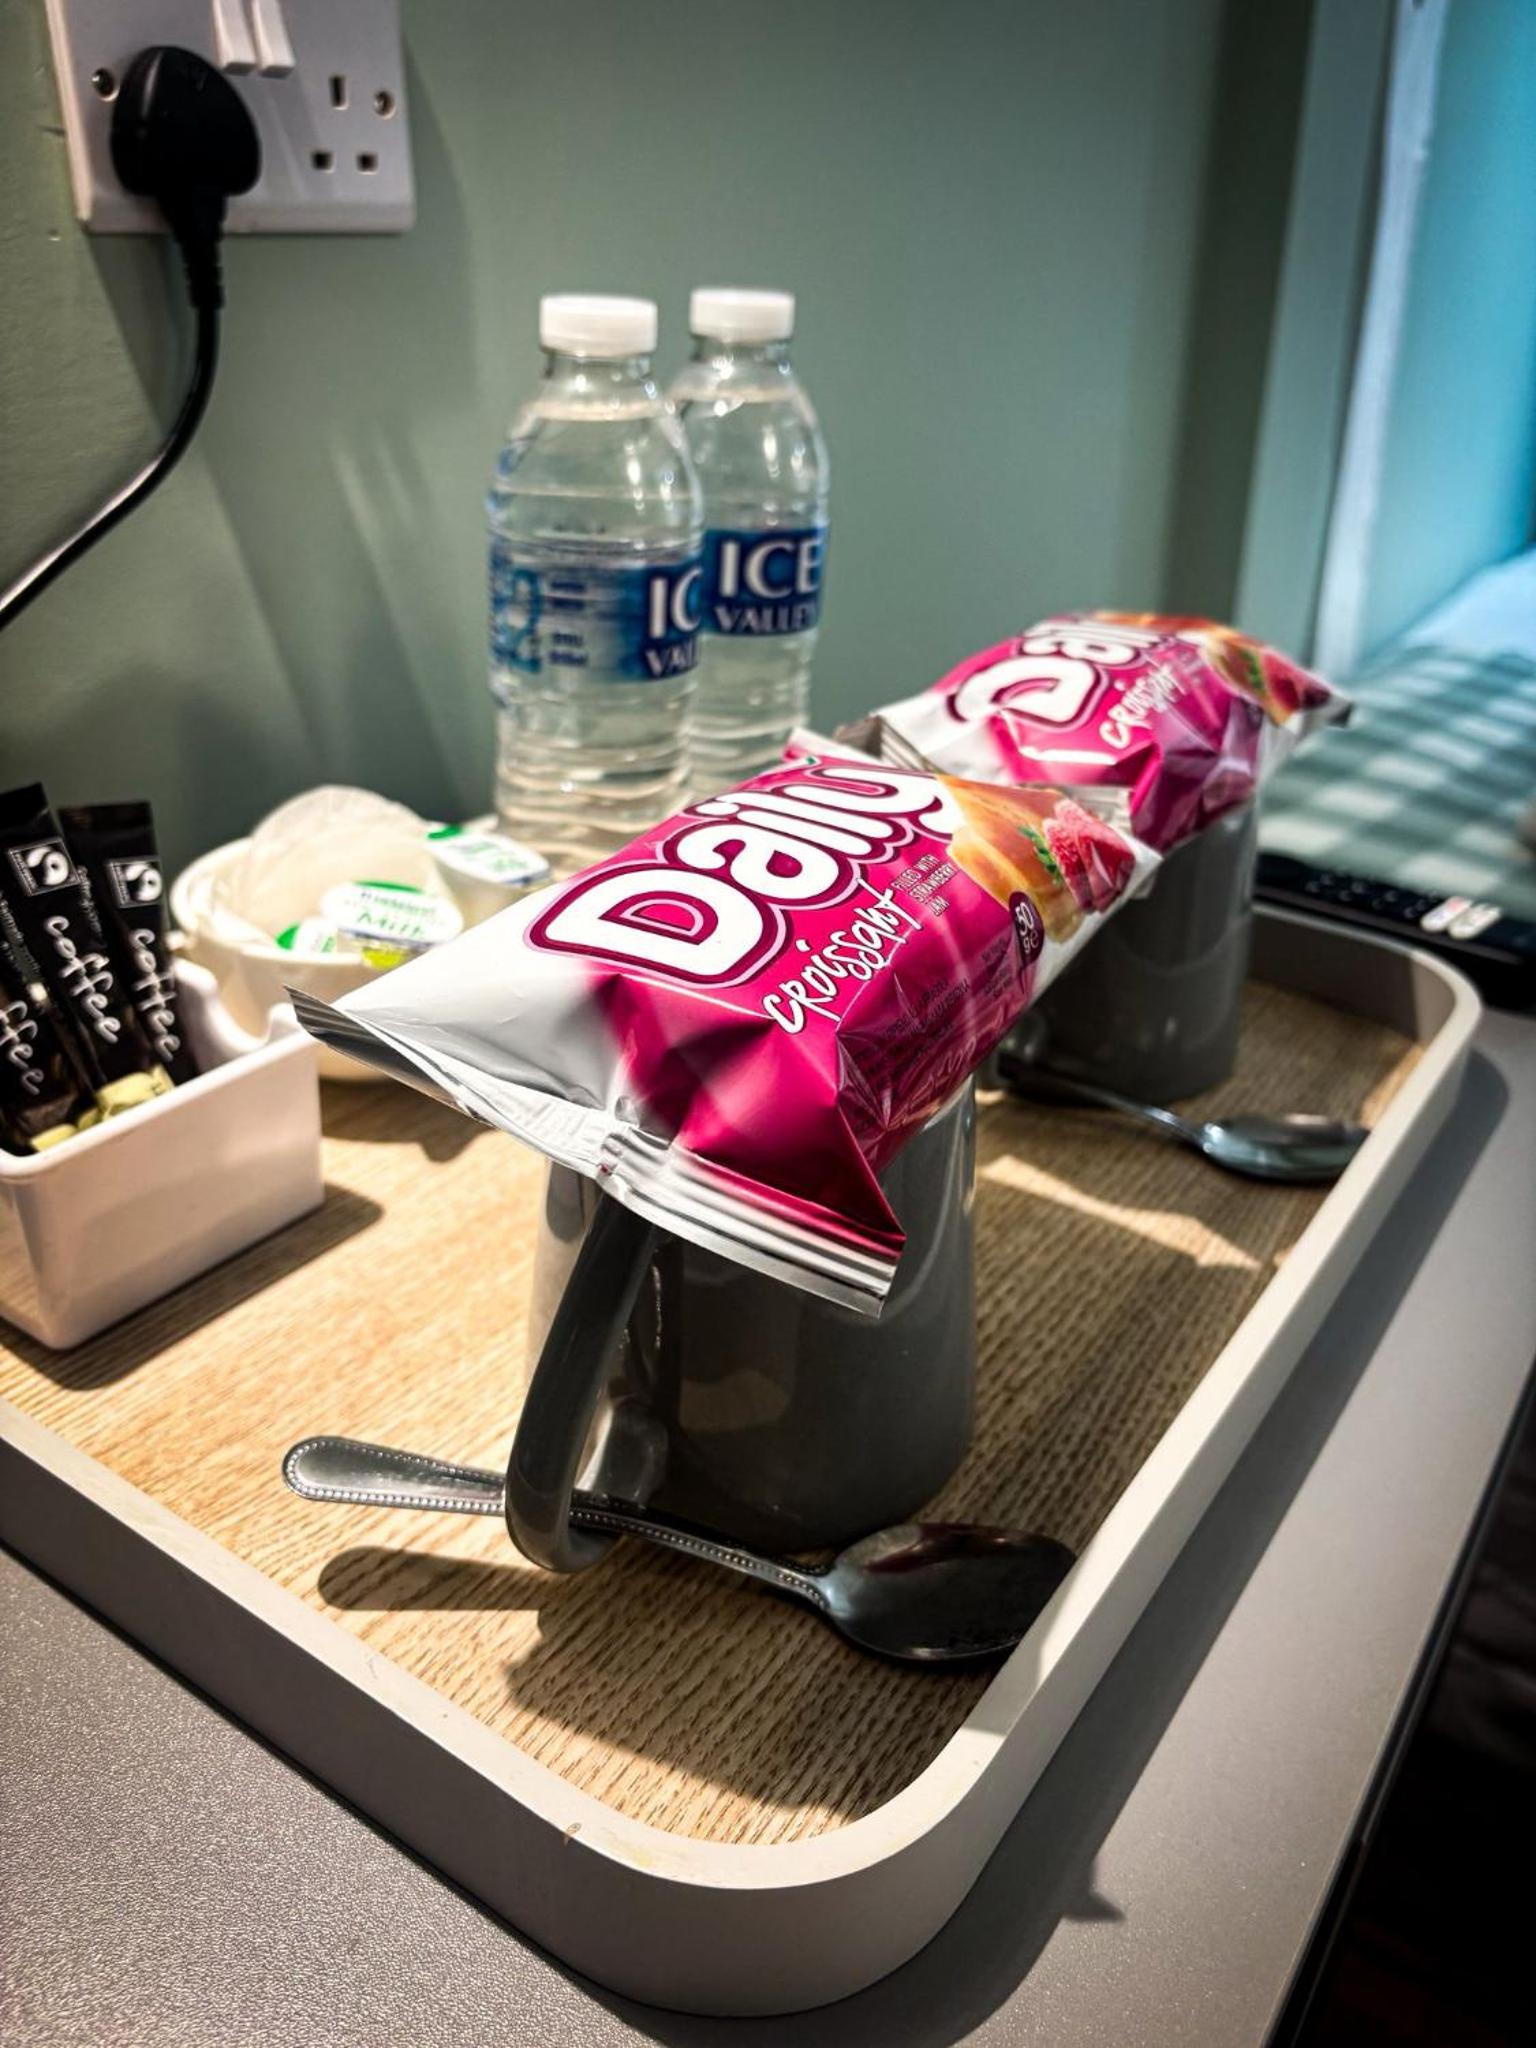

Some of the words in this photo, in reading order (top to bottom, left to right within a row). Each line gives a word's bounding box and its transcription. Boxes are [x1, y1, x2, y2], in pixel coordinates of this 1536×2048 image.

[721, 538, 820, 598] ICE
[650, 567, 702, 639] IC
[535, 767, 957, 983] Daily
[908, 862, 958, 903] STRAWBERRY
[915, 854, 940, 873] WITH
[927, 895, 951, 917] JAM
[1014, 901, 1035, 936] 50
[44, 915, 121, 1044] coffee
[0, 1000, 45, 1096] ffee
